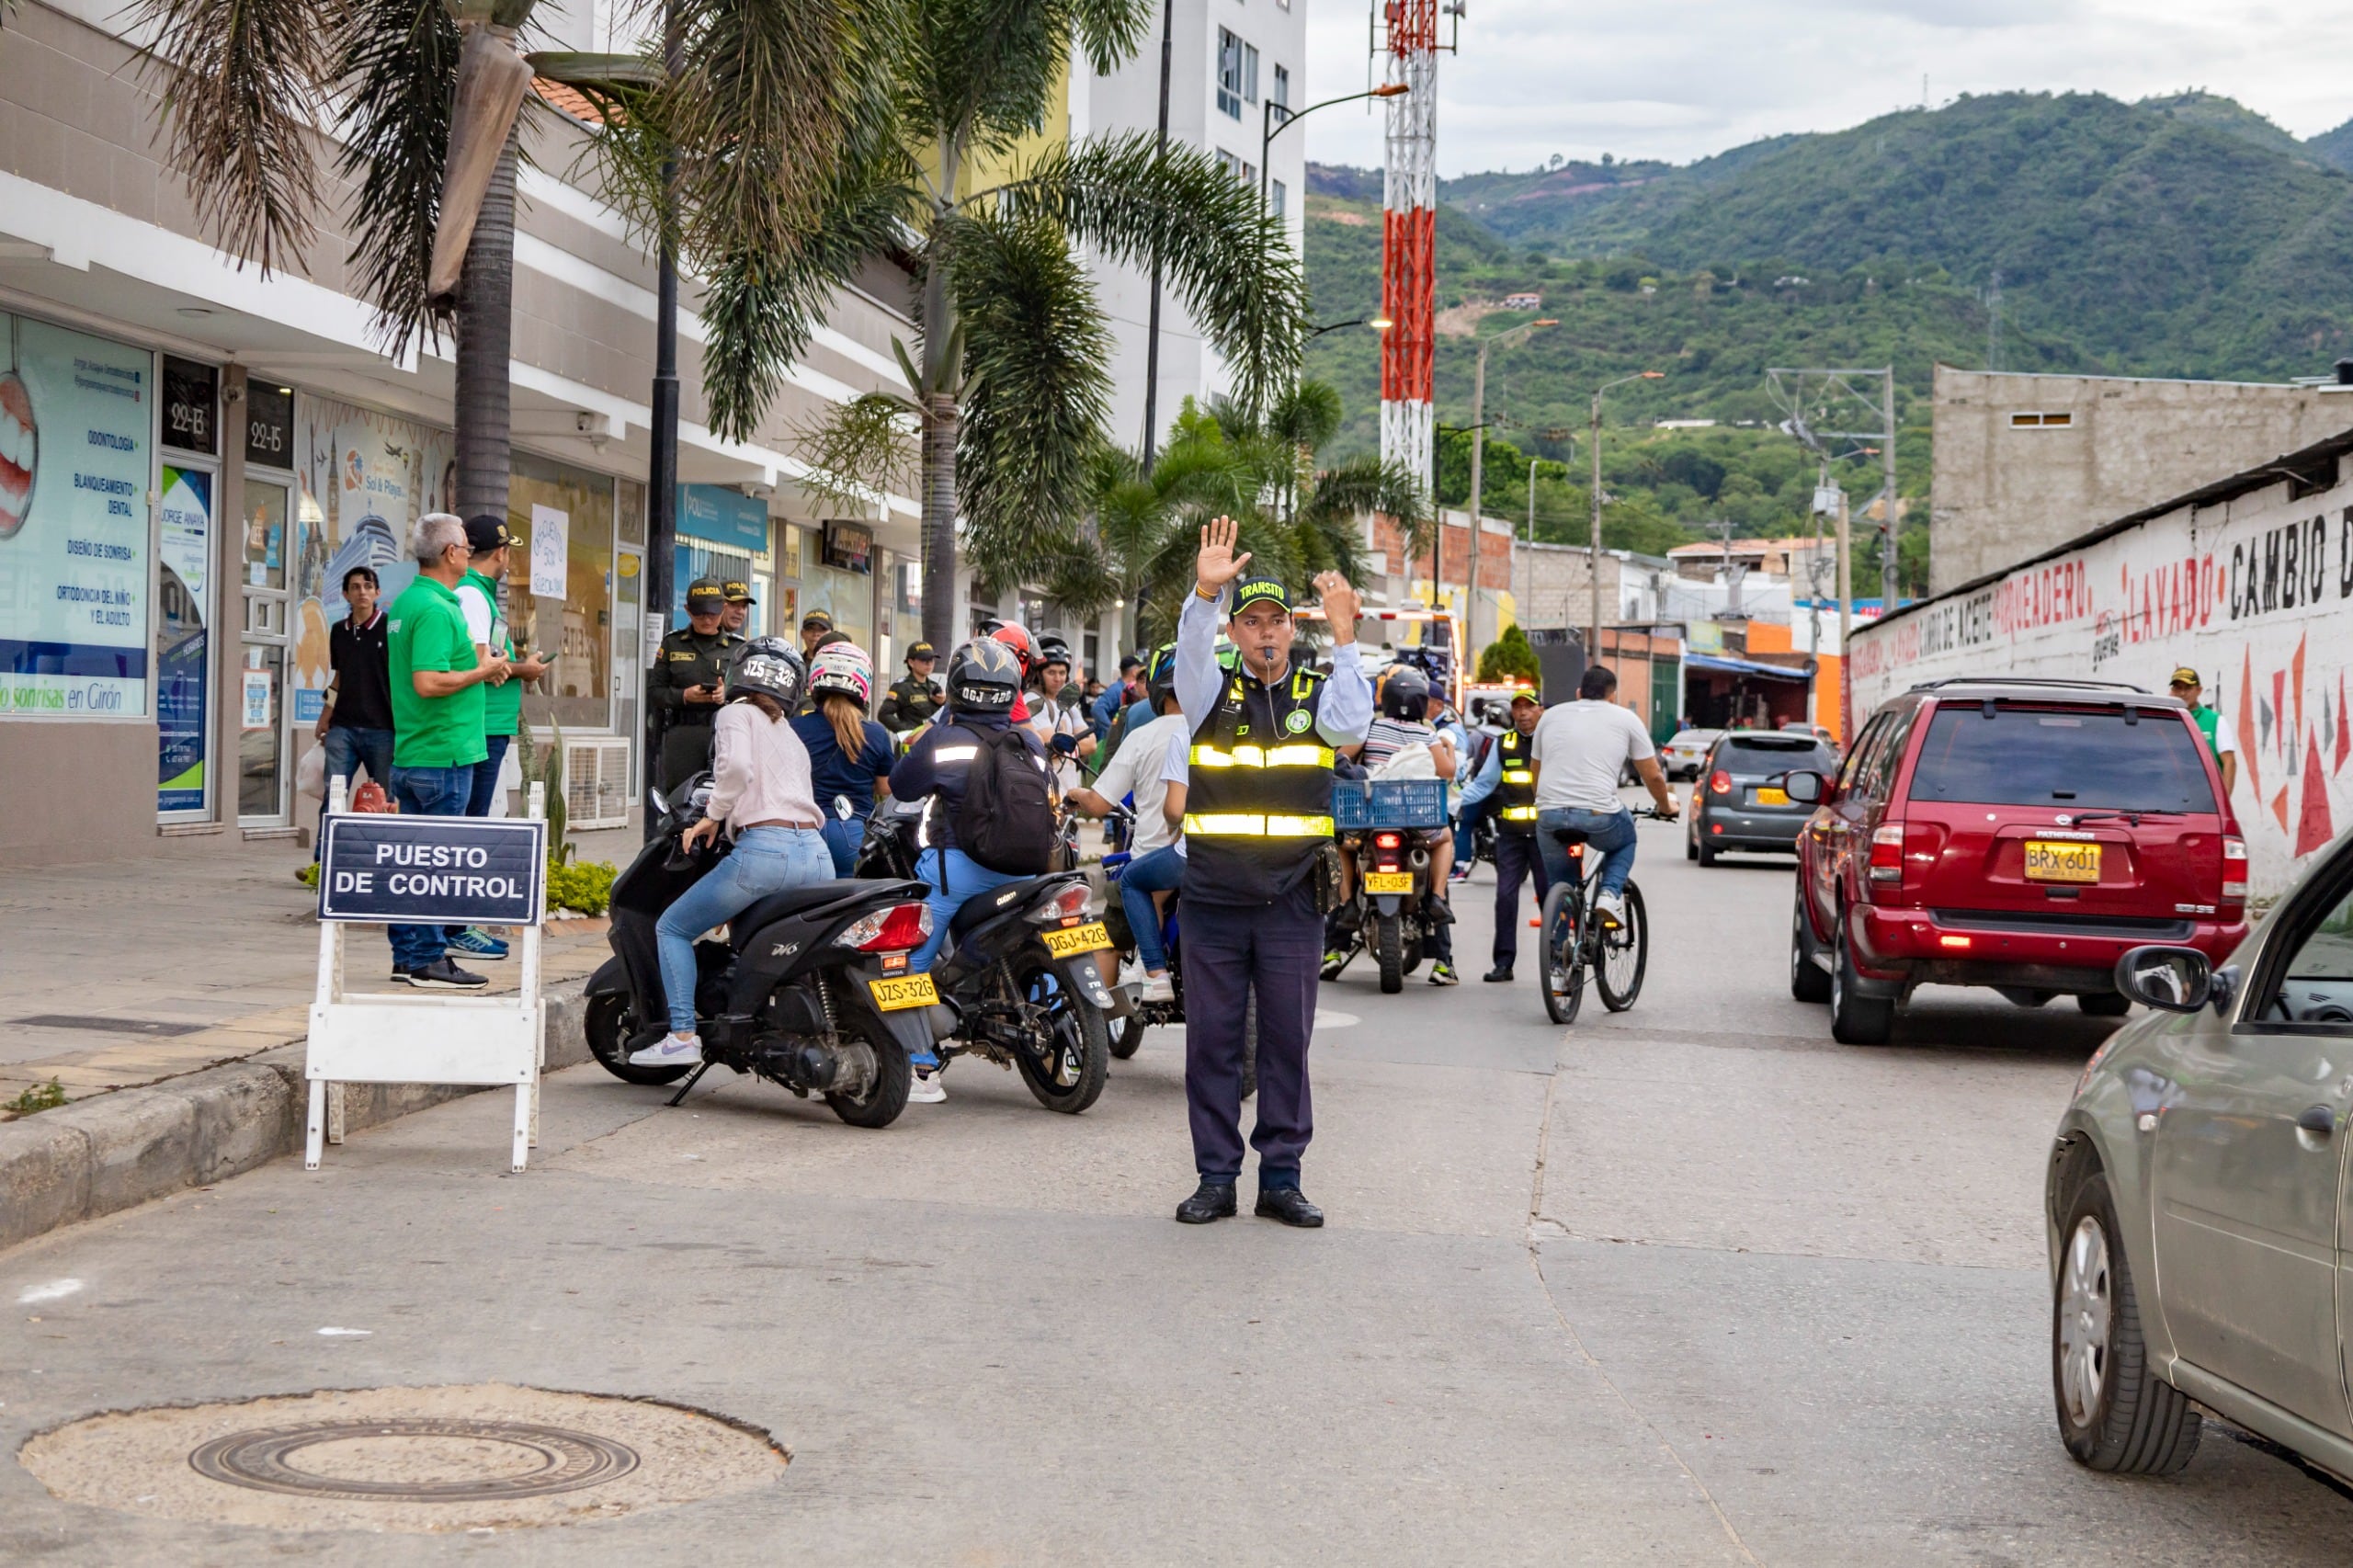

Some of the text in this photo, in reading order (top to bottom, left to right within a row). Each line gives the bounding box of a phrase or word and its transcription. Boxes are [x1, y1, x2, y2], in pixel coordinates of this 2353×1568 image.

[171, 403, 204, 436] 22-13
[88, 429, 134, 452] ODONTOLOGÍA
[251, 421, 281, 452] 22-15
[74, 472, 133, 497] BLANQUEAMIENTO
[108, 500, 132, 517] DENTAL
[161, 508, 204, 528] JORGE ANAYA
[67, 539, 131, 562] DISEÑO DE SONRISA
[1240, 581, 1285, 600] TRANSITO
[2131, 553, 2213, 643] LAVADO
[2231, 515, 2326, 620] CAMBIO
[57, 585, 131, 607] ORTODONCIA DEL NIÑO
[691, 586, 721, 597] POLICIA
[97, 609, 104, 624] EL
[105, 610, 131, 626] ADULTO
[1958, 592, 1991, 647] ACEITE
[744, 660, 796, 687] JZS 32G
[0, 676, 121, 710] o sonrisas en Girón
[2035, 830, 2096, 840] PATHFINDER
[376, 843, 488, 869] PUESTO
[2029, 849, 2097, 870] BRX 601
[335, 871, 524, 899] DE CONTROL
